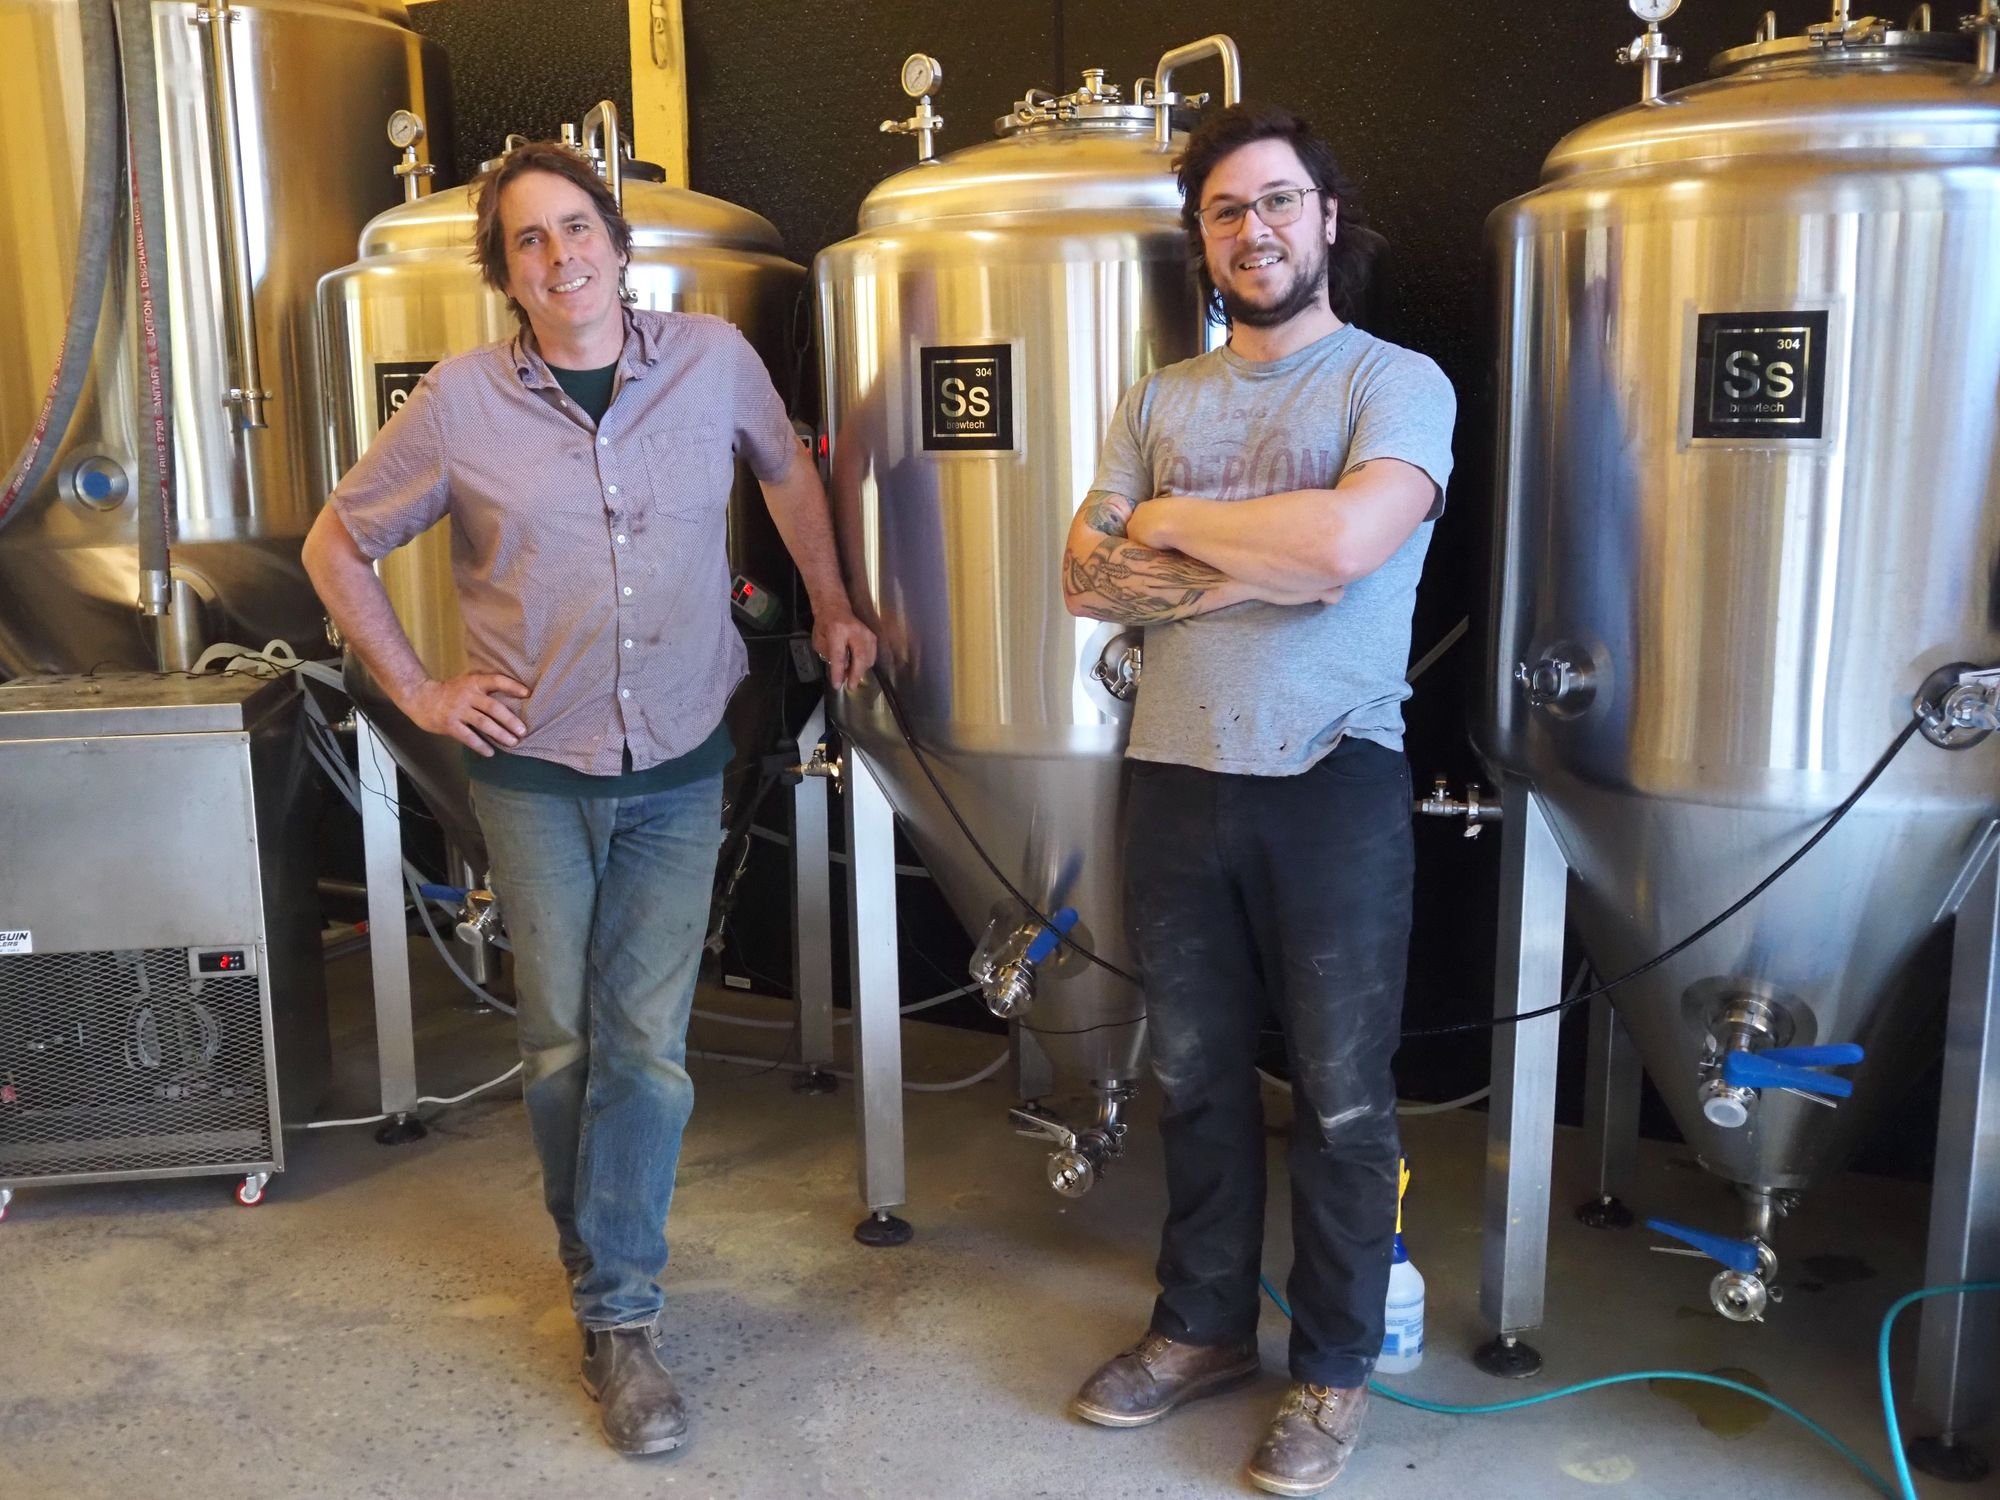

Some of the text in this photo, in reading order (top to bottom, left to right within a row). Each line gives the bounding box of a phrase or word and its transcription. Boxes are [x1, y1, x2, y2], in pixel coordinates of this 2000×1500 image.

[143, 300, 157, 347] SUCTION
[1777, 338, 1800, 350] 304
[975, 367, 992, 377] 304
[1723, 350, 1794, 398] Ss
[941, 377, 990, 417] Ss
[1729, 402, 1785, 413] brtech
[155, 419, 165, 443] 2720
[946, 419, 985, 430] brewtech
[158, 444, 167, 481] ERIS
